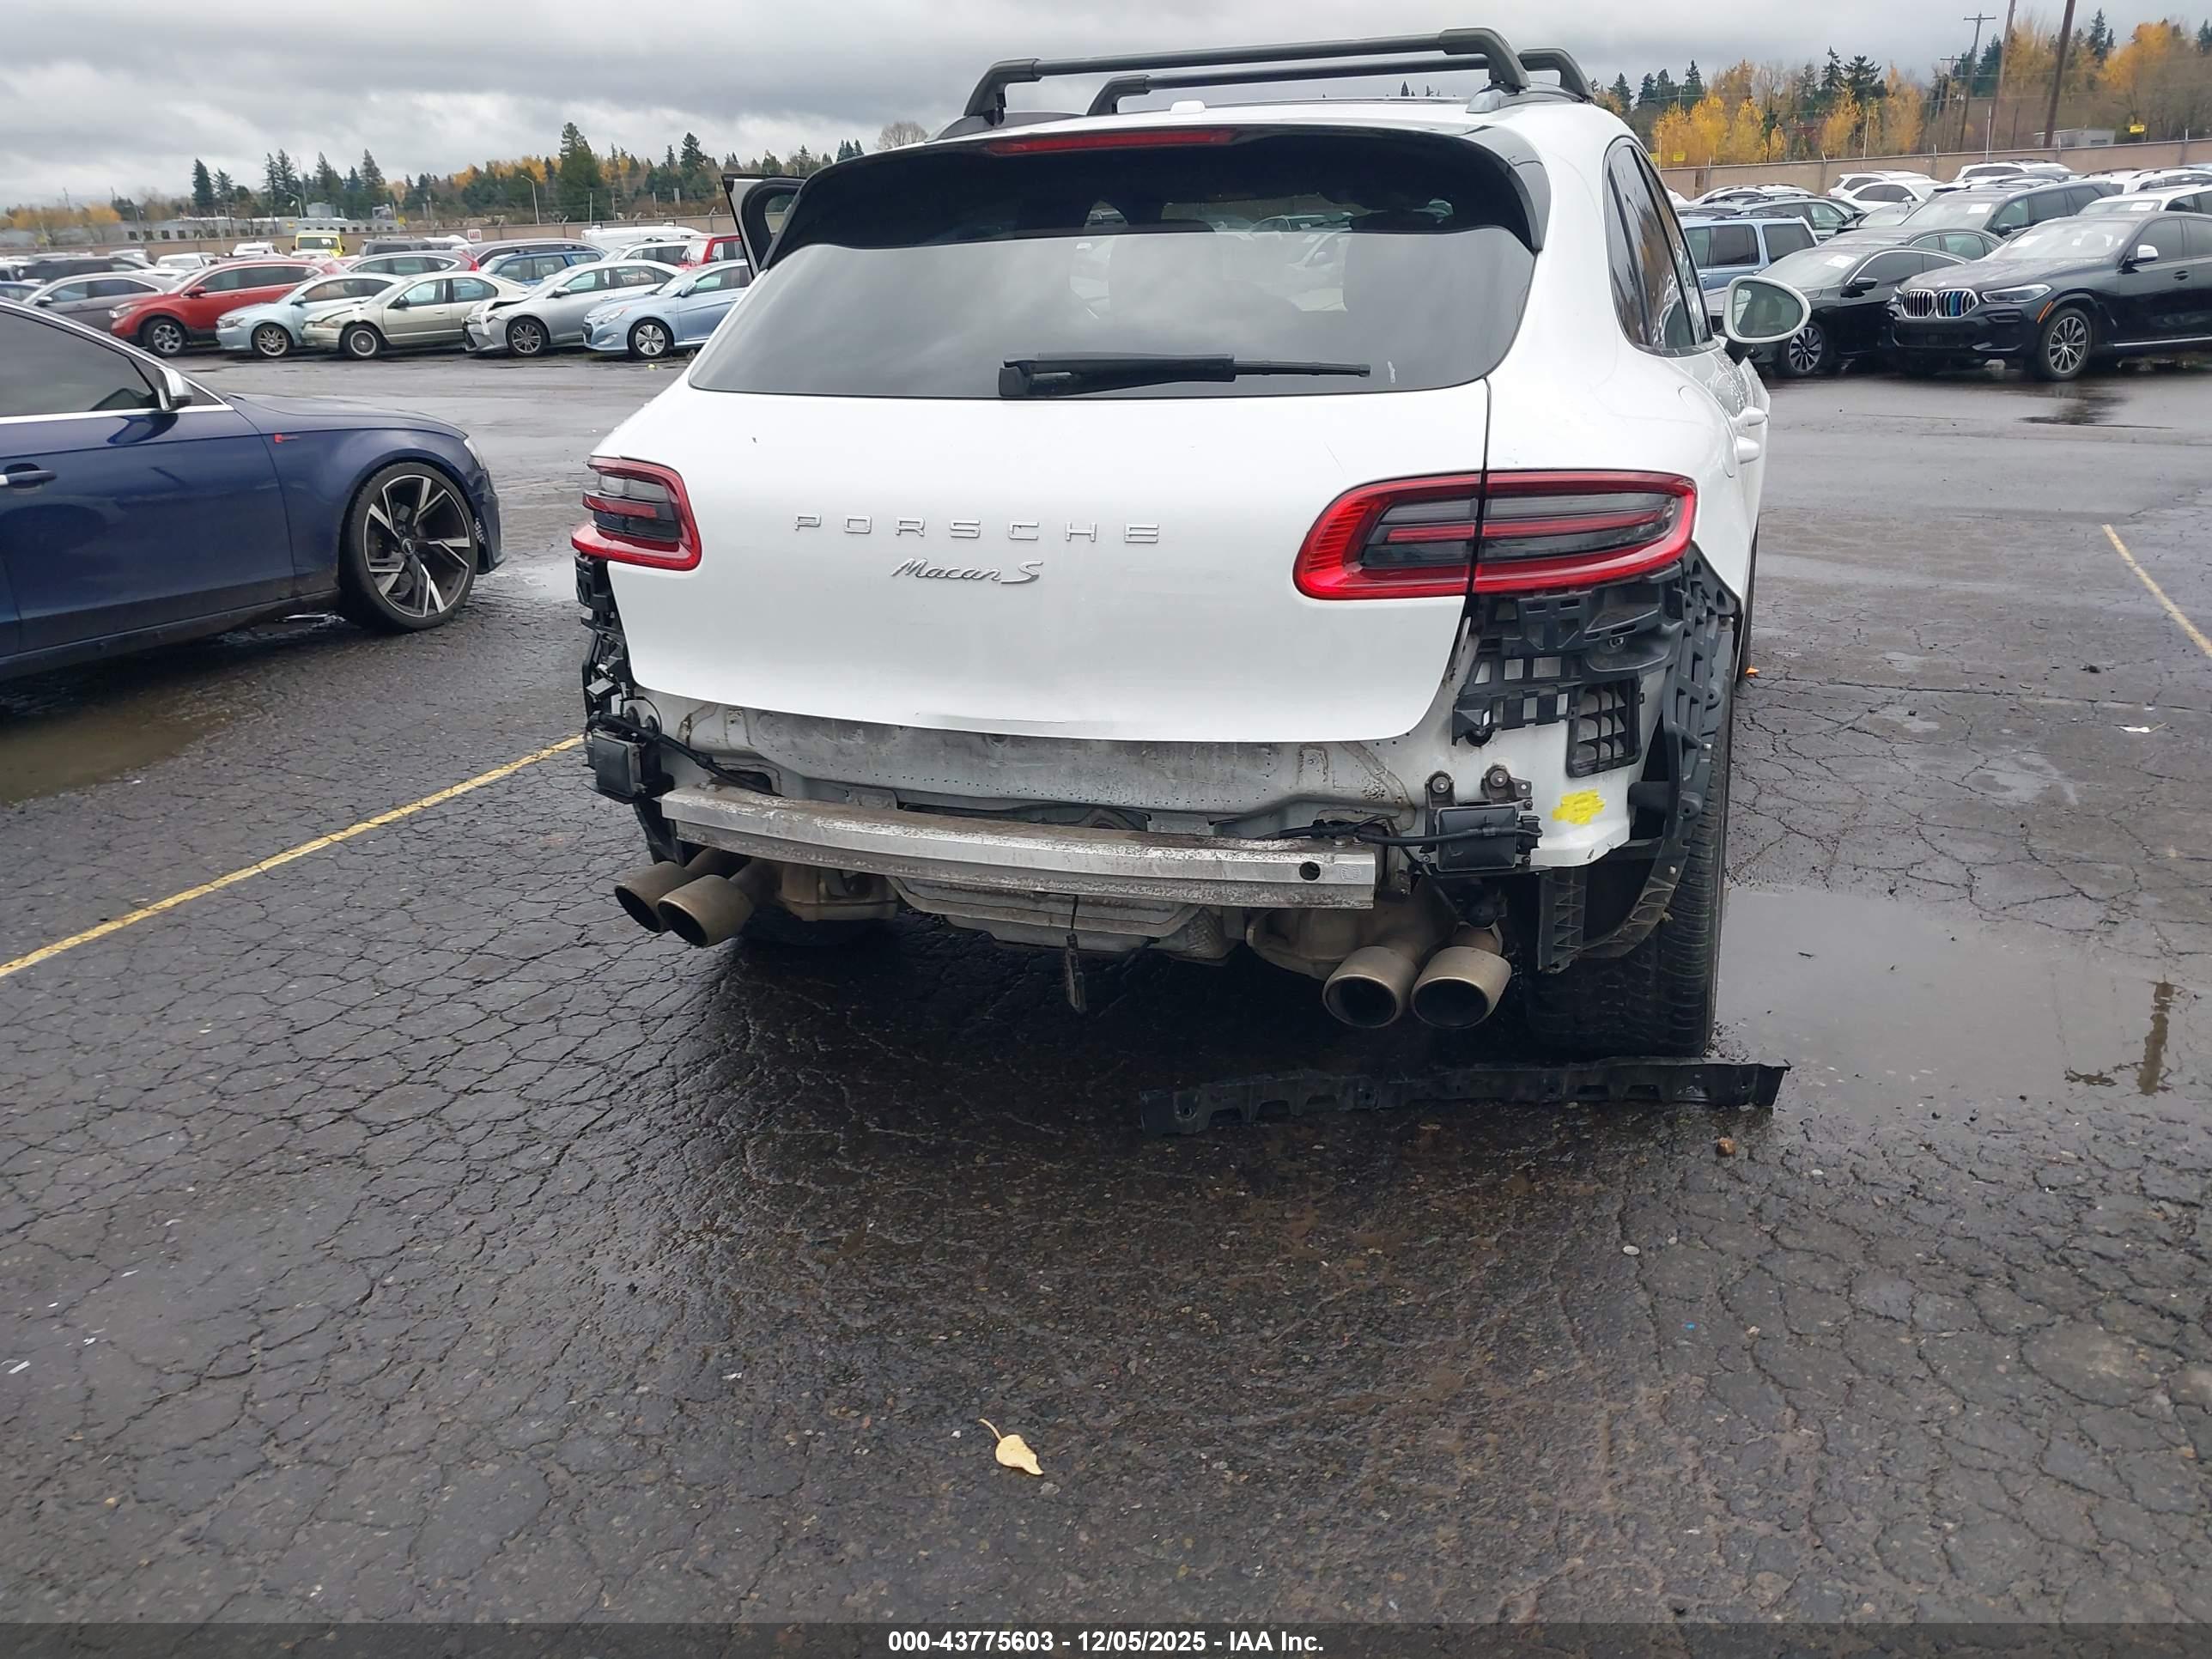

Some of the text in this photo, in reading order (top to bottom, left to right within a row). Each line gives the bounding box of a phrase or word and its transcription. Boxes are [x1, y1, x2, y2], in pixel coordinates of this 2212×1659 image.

[794, 513, 1159, 544] PORSCHE
[890, 557, 1044, 585] Macan S
